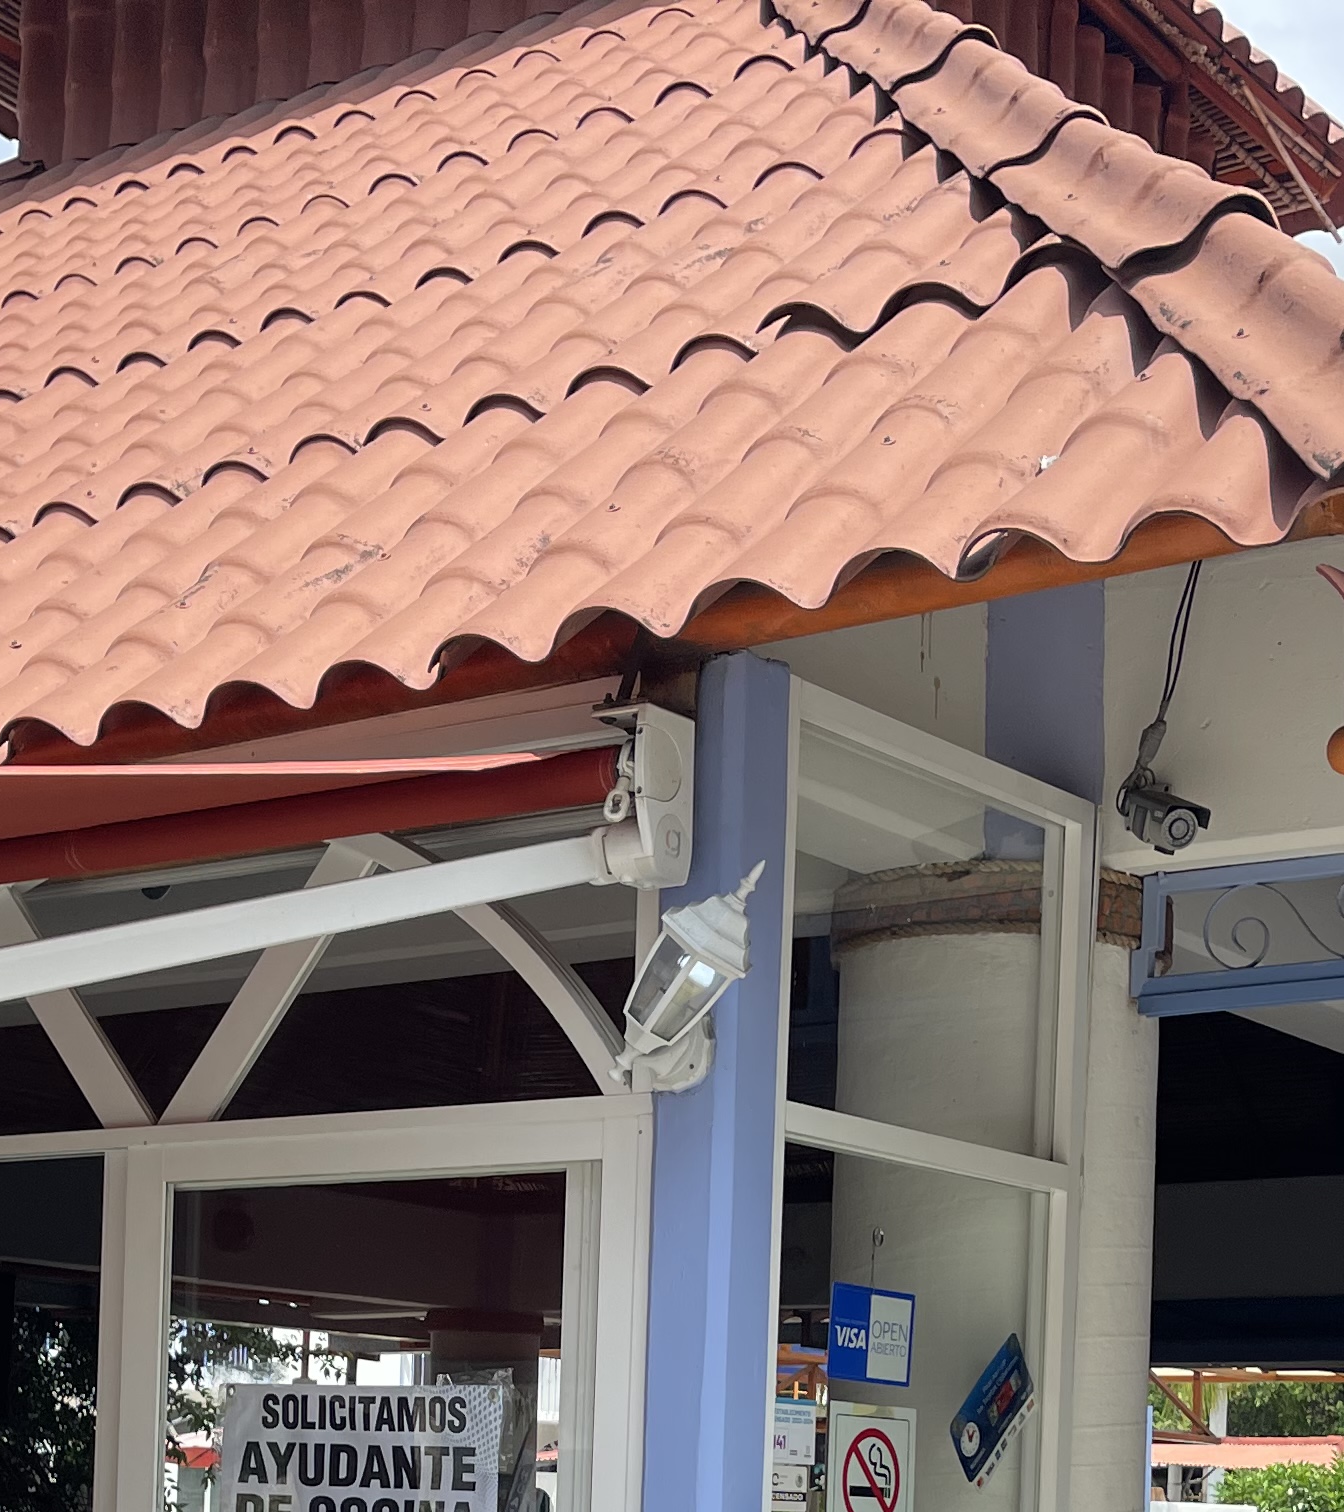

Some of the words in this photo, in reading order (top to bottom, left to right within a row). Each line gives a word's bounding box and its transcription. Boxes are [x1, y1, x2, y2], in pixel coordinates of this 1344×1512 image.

[835, 1324, 867, 1350] VISA
[871, 1319, 909, 1344] OPEN
[869, 1341, 907, 1359] ABIERTO
[261, 1393, 467, 1433] SOLICITAMOS
[238, 1441, 477, 1492] AYUDANTE
